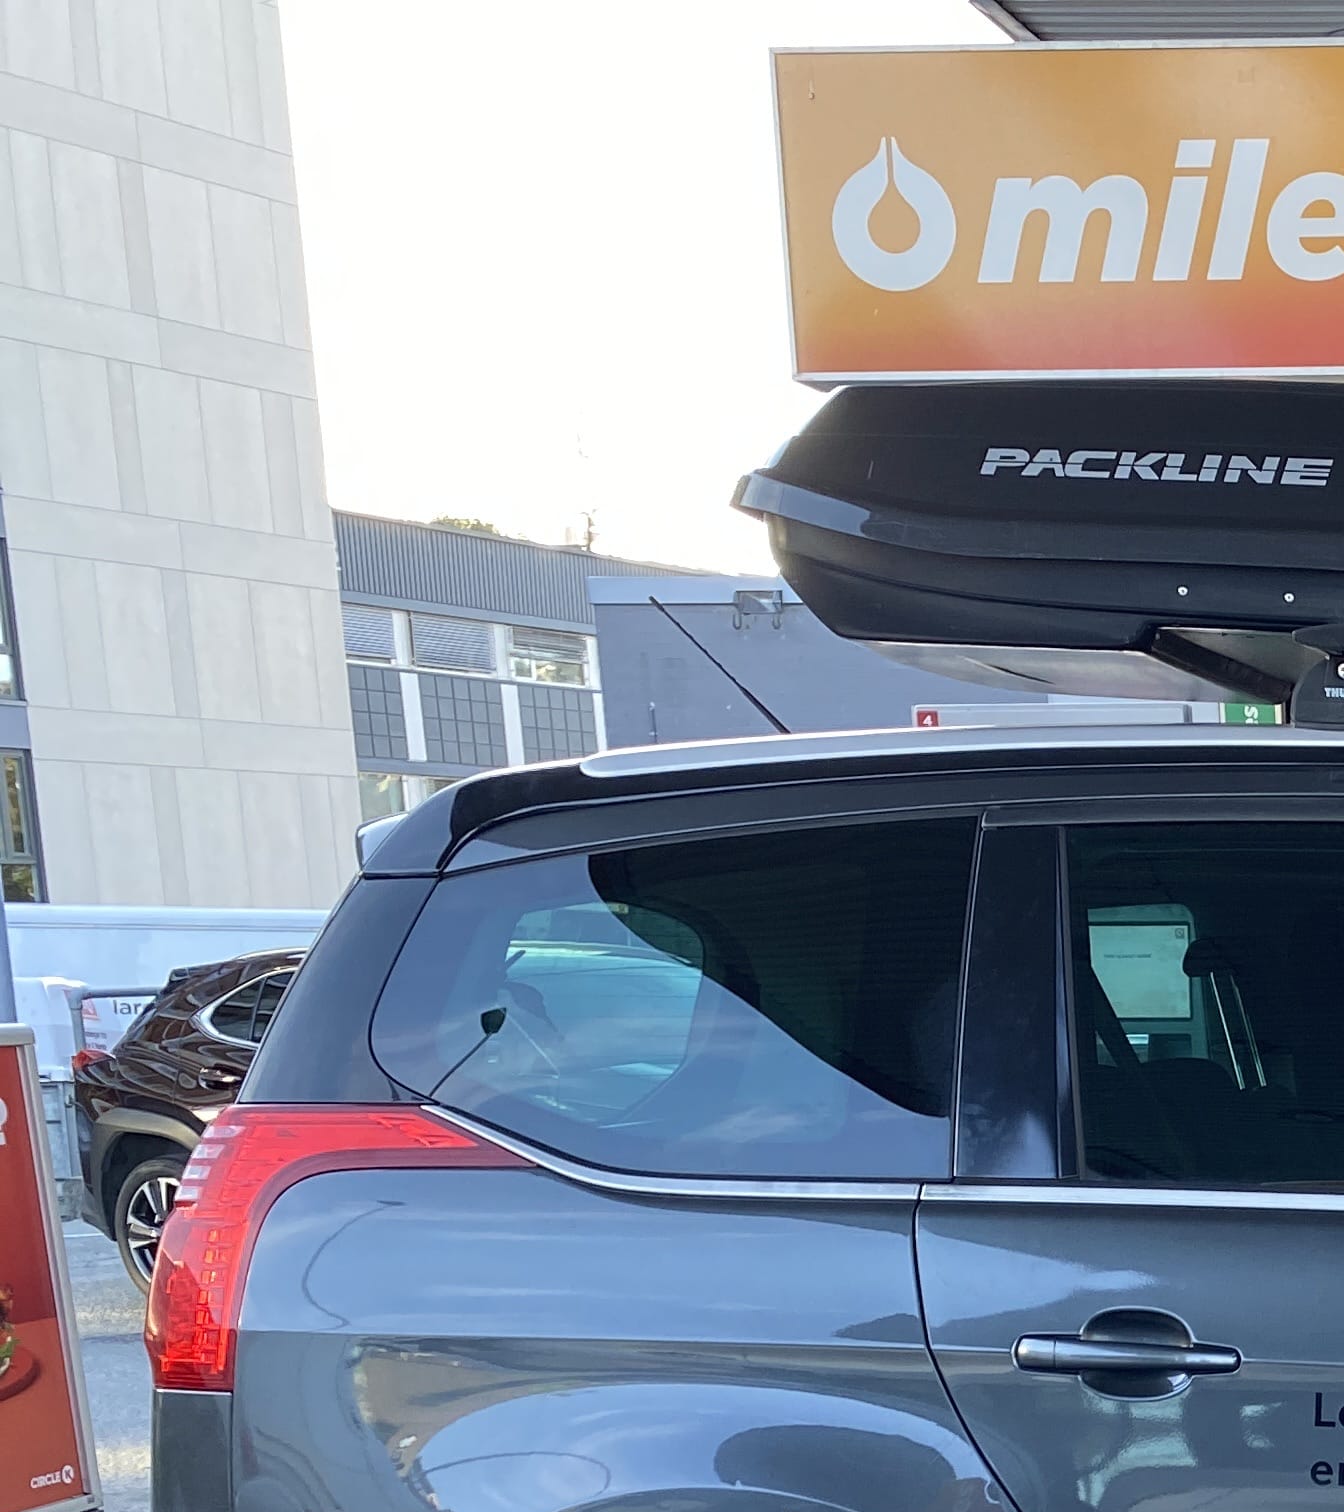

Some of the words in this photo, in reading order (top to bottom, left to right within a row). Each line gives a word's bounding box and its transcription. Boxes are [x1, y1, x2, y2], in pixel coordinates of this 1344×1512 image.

[979, 447, 1335, 487] PACKLINE
[922, 714, 933, 728] 4
[30, 1470, 61, 1489] CIRCLE
